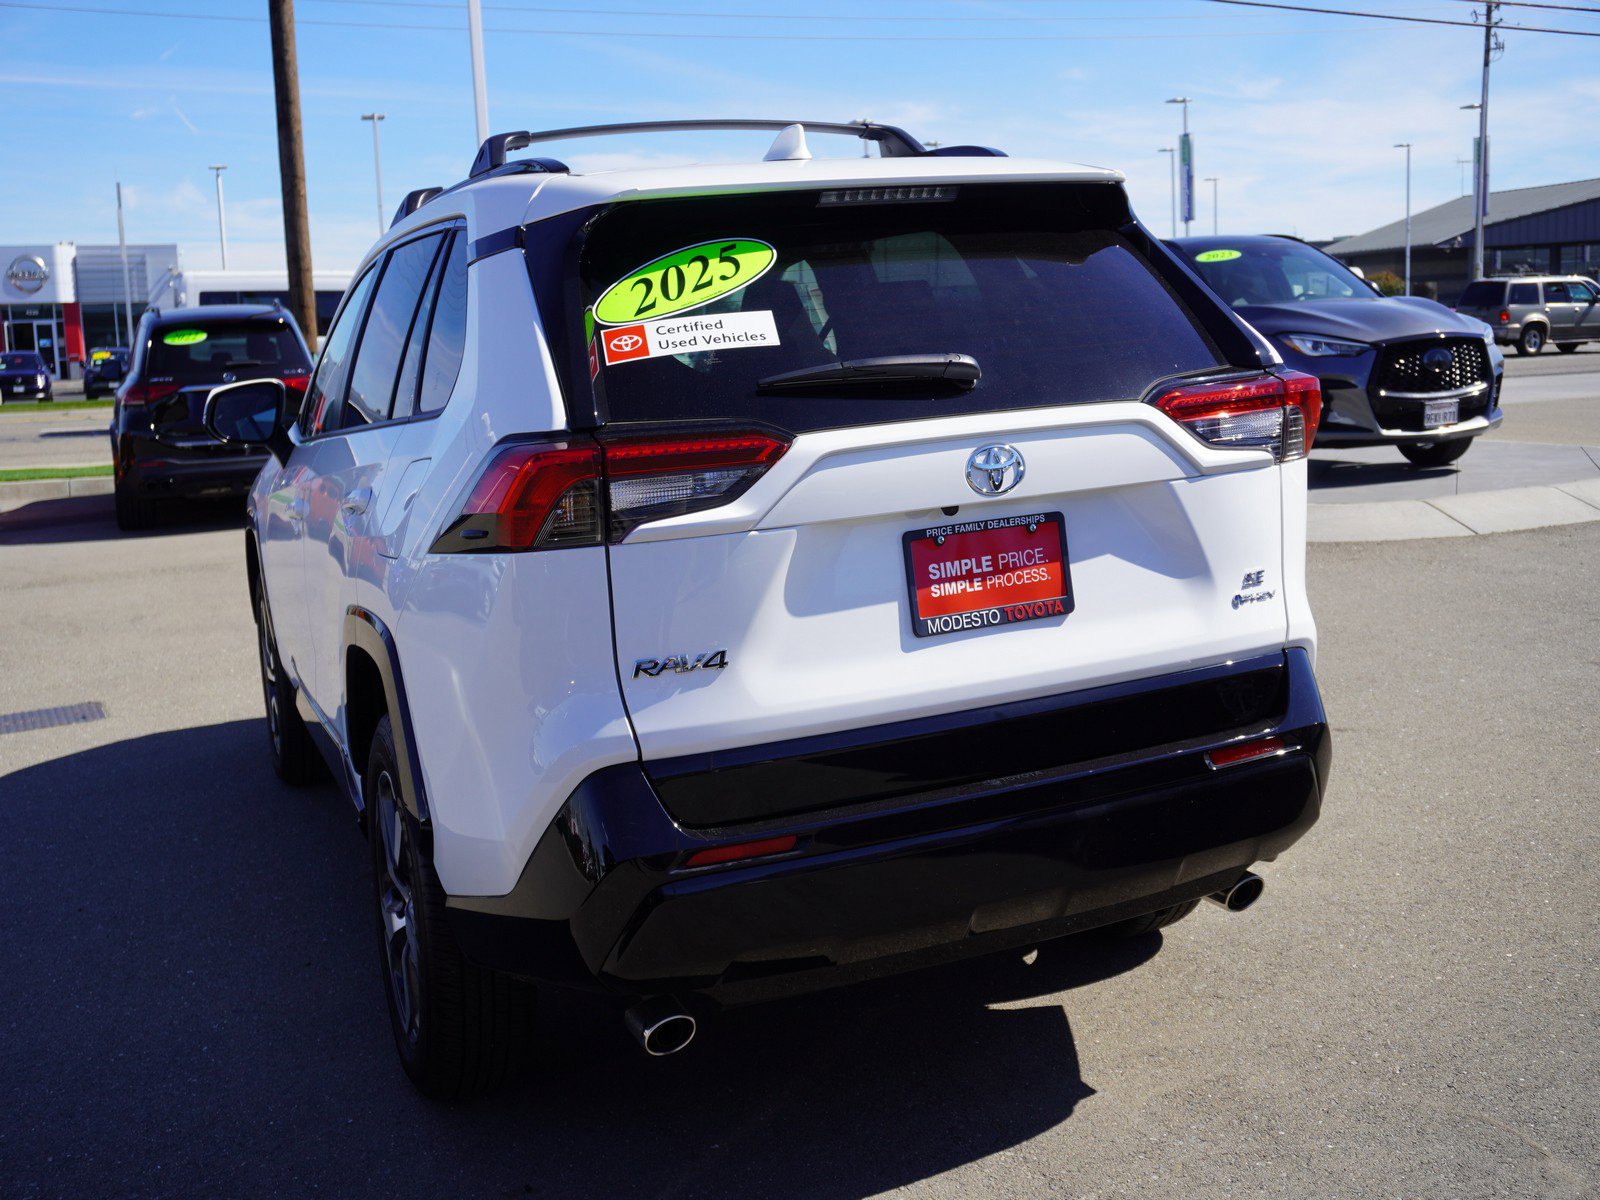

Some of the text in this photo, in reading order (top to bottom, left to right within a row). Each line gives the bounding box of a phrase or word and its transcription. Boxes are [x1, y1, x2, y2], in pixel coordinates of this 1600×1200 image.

[630, 243, 741, 318] 2025
[656, 319, 724, 336] Certified
[658, 331, 767, 350] Used Vehicles
[926, 514, 1046, 538] PRICE FAMILY DEALERSHIPS
[928, 547, 1049, 580] SIMPLE PRICE.
[930, 567, 1052, 598] SIMPLE PROCESS.
[927, 600, 1065, 634] MODESTO TOYOTA
[631, 648, 729, 679] RAV4
